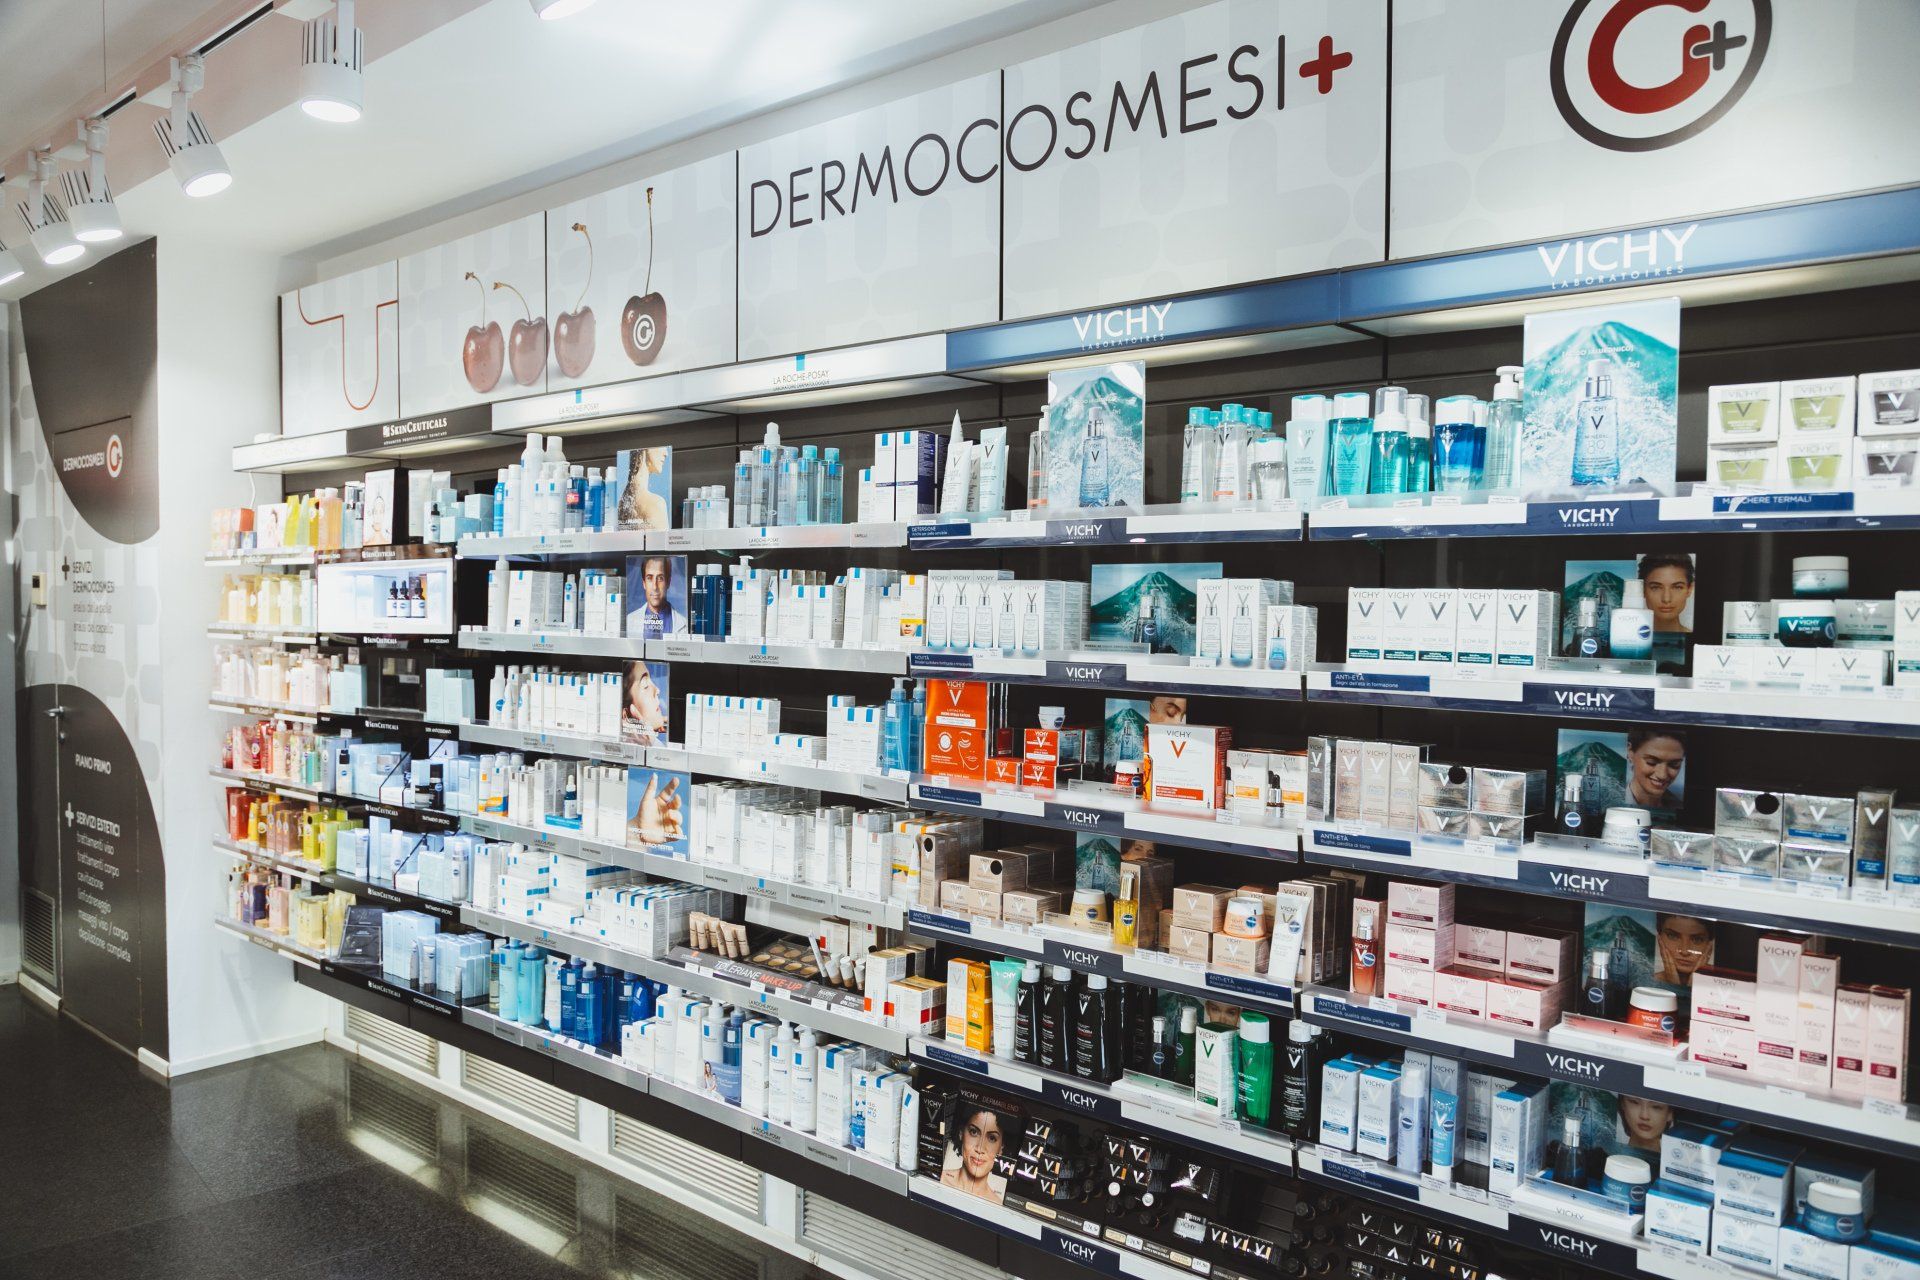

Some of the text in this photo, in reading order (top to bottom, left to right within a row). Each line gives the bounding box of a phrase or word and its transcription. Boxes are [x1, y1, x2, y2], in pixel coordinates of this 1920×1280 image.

[1537, 224, 1699, 278] VICHY
[1552, 265, 1685, 290] LABORATOIRES
[1072, 301, 1173, 341] VICHY
[1081, 334, 1165, 351] LABORATOIRES
[63, 452, 105, 472] DERMOCOSMESI
[1772, 495, 1813, 504] TERMALI
[1558, 507, 1620, 523] VICHY
[1066, 524, 1102, 535] VICHY
[1352, 591, 1380, 599] VICHY
[1387, 591, 1416, 599] VICHY
[1423, 591, 1452, 600] VICHY
[1462, 591, 1493, 600] VICHY
[1502, 592, 1533, 601] VICHY
[1065, 666, 1103, 679] VICHY
[1335, 673, 1365, 682] ANTI-ETÀ
[1554, 690, 1616, 708] VICHY
[1166, 730, 1192, 738] VICHY
[1309, 743, 1325, 751] VICHY
[1339, 748, 1361, 756] VICHY
[1393, 752, 1417, 760] VICHY
[75, 753, 112, 775] PIANO PRIMO
[1063, 810, 1101, 824] VICHY
[1433, 809, 1453, 817] VICHY
[76, 811, 121, 837] SERVIZI ESTETICI
[1320, 832, 1349, 842] ANTI-ETÀ
[104, 841, 115, 856] viso
[104, 863, 120, 879] corpo
[1549, 871, 1610, 892] VICHY
[1283, 888, 1308, 898] VICHY
[1403, 885, 1423, 894] VICHY
[1355, 905, 1377, 914] VICHY
[112, 926, 129, 942] corpo
[1400, 926, 1420, 935] VICHY
[1470, 927, 1490, 936] VICHY
[1523, 935, 1543, 944] VICHY
[1354, 942, 1369, 950] VICHY
[1062, 948, 1100, 966] VICHY
[1763, 946, 1798, 958] VICHY
[968, 970, 983, 979] VICHY
[1804, 964, 1831, 974] VICHY
[715, 961, 803, 991] TOLERIANE MAKE-UP
[1450, 976, 1470, 986] VICHY
[1713, 977, 1737, 988] VICHY
[1503, 986, 1523, 995] VICHY
[1318, 1000, 1347, 1013] ANTI-ETÀ
[1838, 996, 1867, 1007] VICHY
[1641, 1015, 1660, 1023] VICHY
[1198, 1031, 1219, 1041] VICHY
[1406, 1057, 1428, 1069] VICHY
[1546, 1052, 1605, 1077] VICHY
[1433, 1064, 1456, 1075] VICHY
[1328, 1070, 1348, 1081] VICHY
[1468, 1075, 1488, 1086] VICHY
[1365, 1079, 1386, 1089] VICHY
[923, 1097, 942, 1110] VICHY
[960, 1089, 1019, 1113] VICHY DERMABLEND
[1061, 1089, 1098, 1109] VICHY
[1496, 1103, 1517, 1114] VICHY
[1680, 1140, 1703, 1151] VICHY
[1326, 1162, 1367, 1179] IDRATAZIONE
[1737, 1170, 1762, 1182] VICHY
[1815, 1171, 1840, 1185] VICHY
[1555, 1207, 1584, 1220] VICHY
[1539, 1228, 1598, 1256] VICHY
[1060, 1238, 1097, 1261] VICHY
